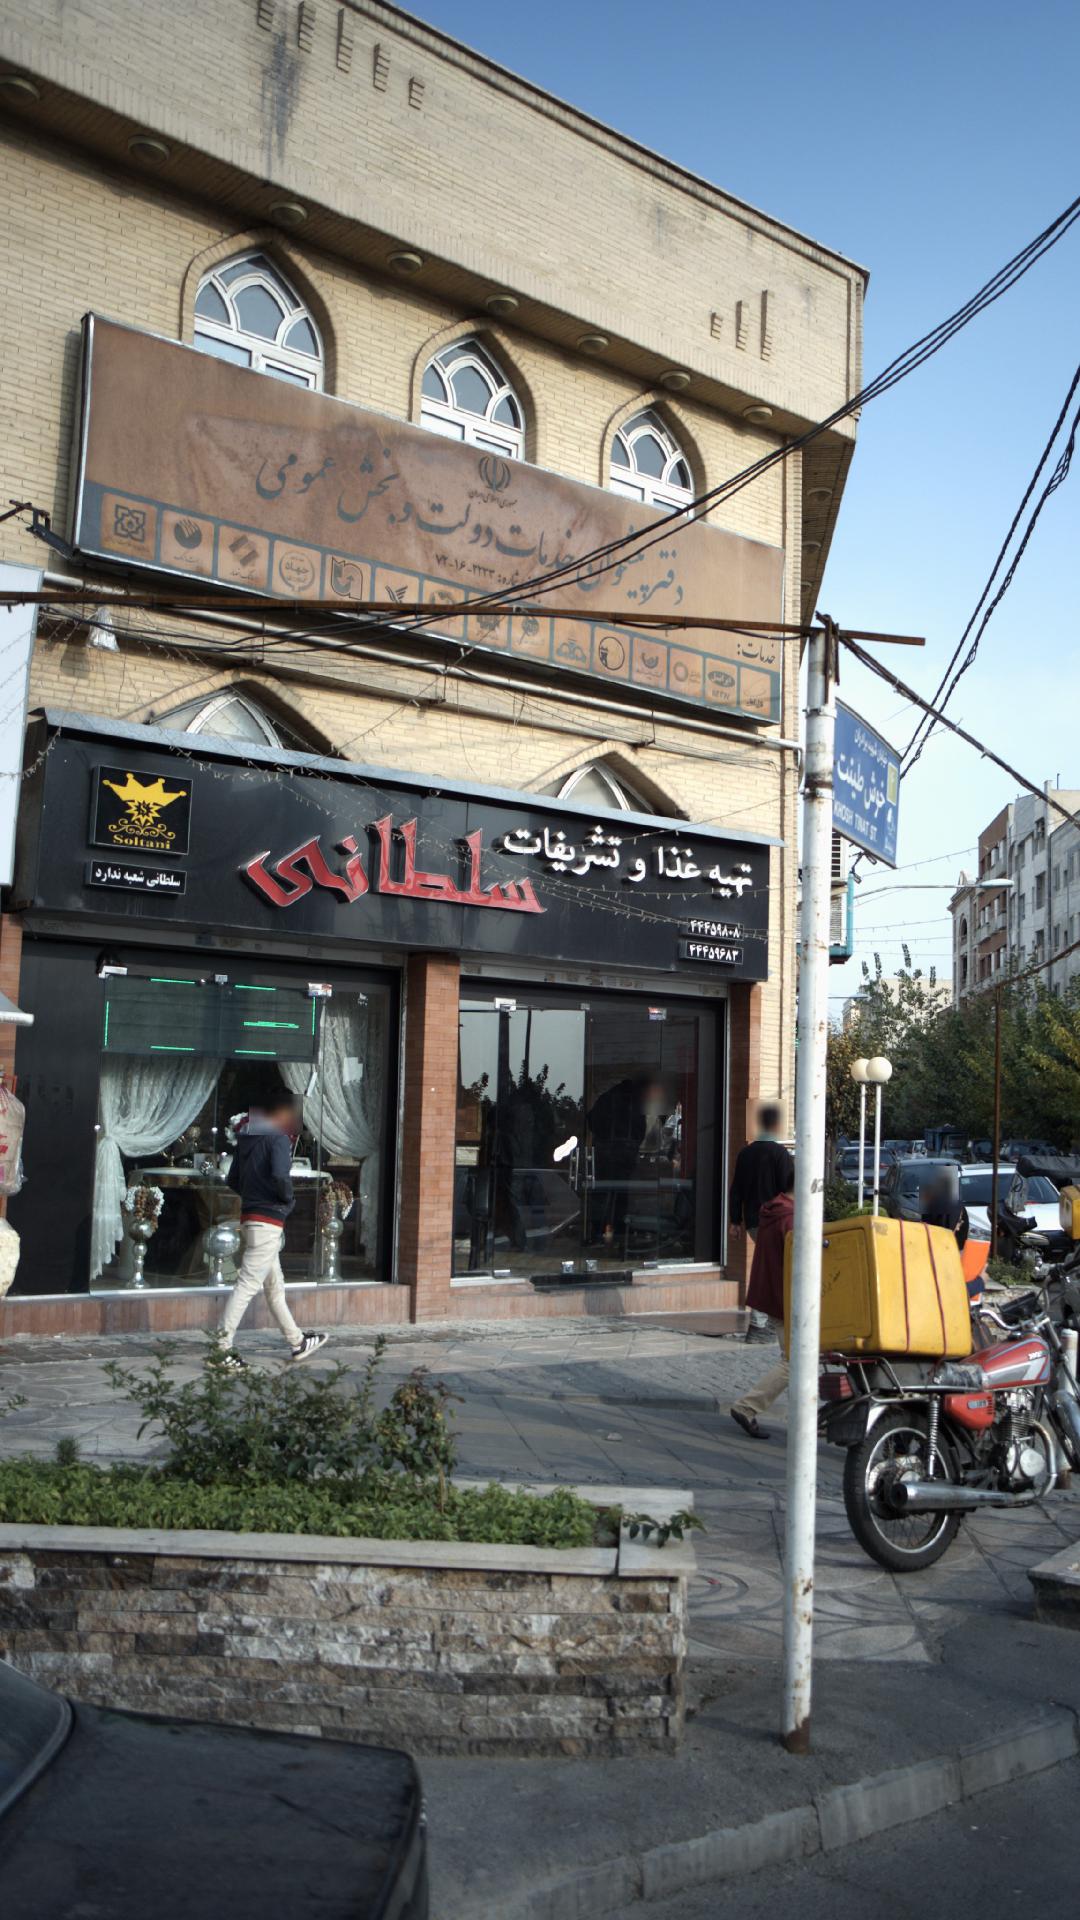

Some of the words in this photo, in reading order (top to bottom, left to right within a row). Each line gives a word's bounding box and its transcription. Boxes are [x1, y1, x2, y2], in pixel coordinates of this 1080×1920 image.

[255, 453, 336, 501] عمومی
[337, 447, 400, 524] بخش
[398, 502, 414, 524] و
[416, 502, 494, 549] دولت
[495, 524, 575, 572] خدمات
[638, 549, 684, 607] دفتر
[837, 751, 865, 800] طینت
[864, 770, 886, 819] خوش
[113, 834, 171, 849] Soltani
[503, 825, 623, 876] تشریفات
[95, 867, 122, 882] ندارد
[123, 871, 145, 885] شعبه
[146, 872, 181, 887] سلطانی
[247, 813, 548, 913] سلطانی
[627, 858, 647, 881] و
[658, 845, 701, 879] غذا
[708, 862, 753, 897] تهیه
[690, 919, 740, 938] ۴۴۴۵۹۸۰۸
[689, 944, 739, 962] ۴۴۴۵۹۶۸۳
